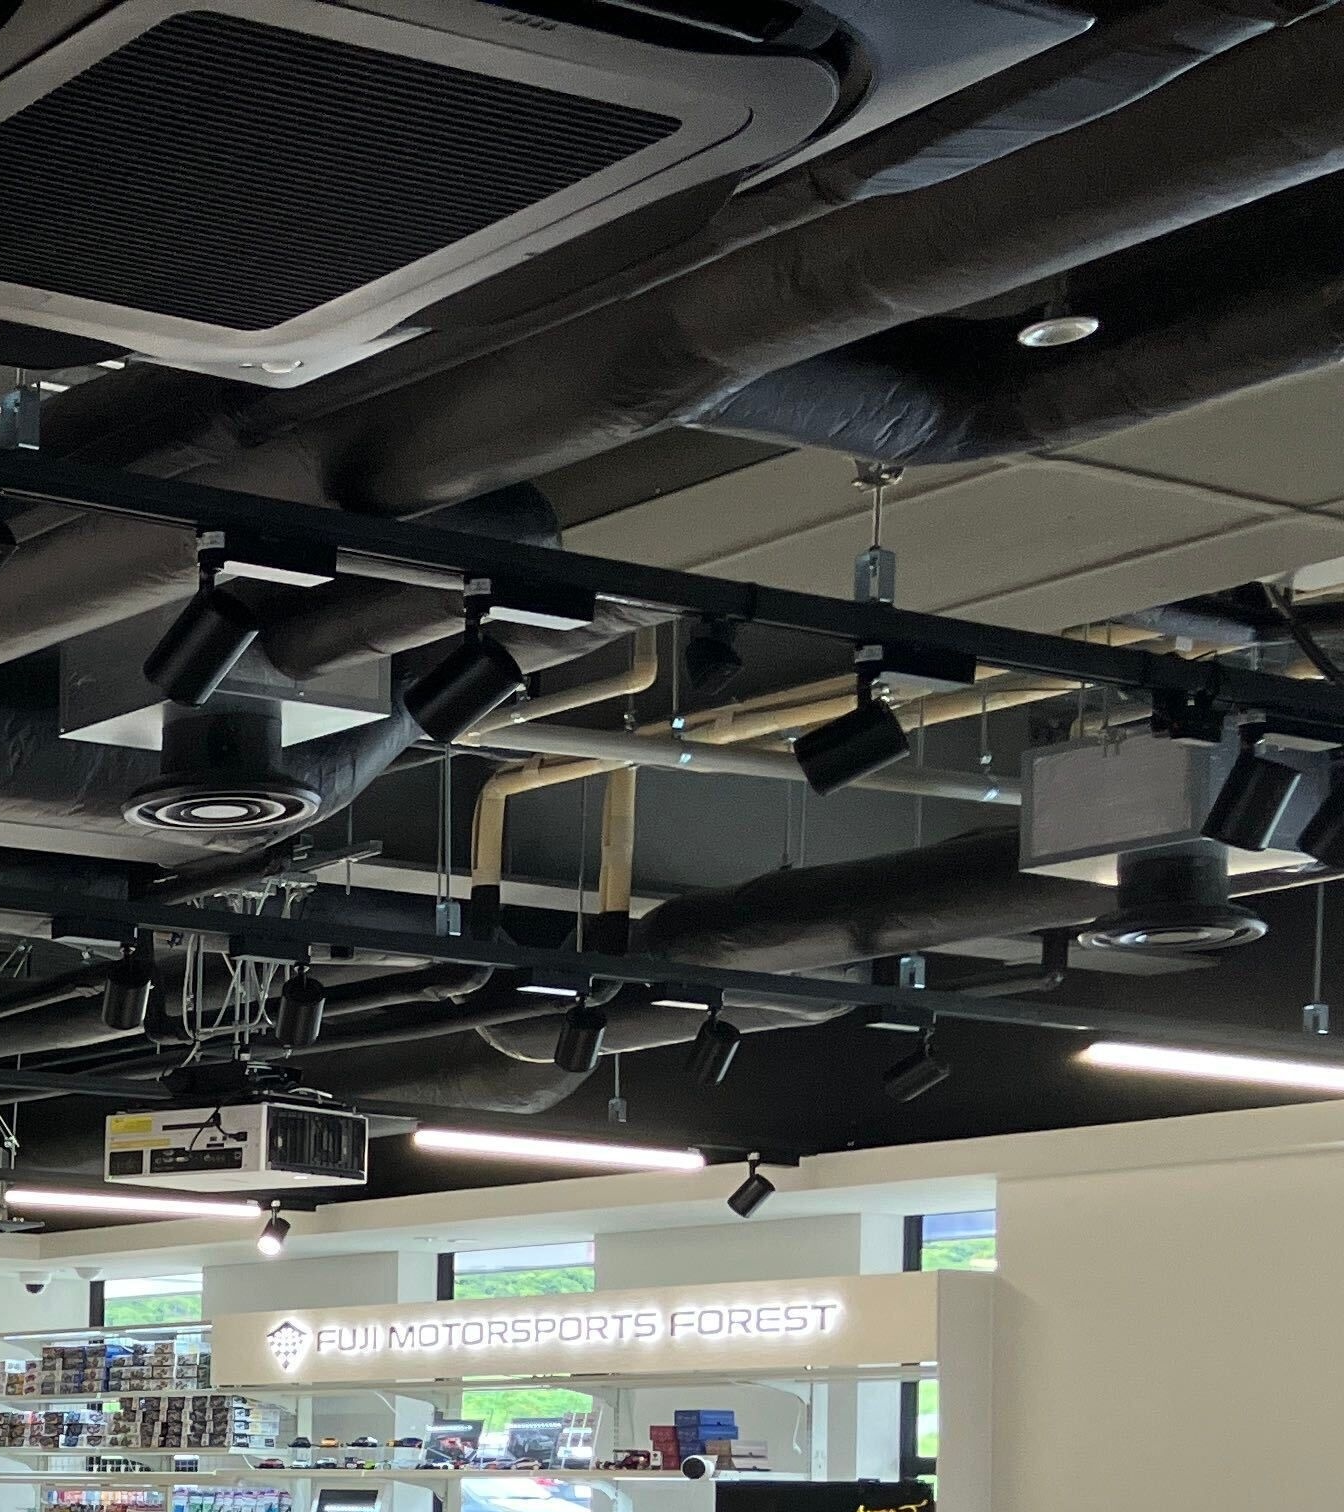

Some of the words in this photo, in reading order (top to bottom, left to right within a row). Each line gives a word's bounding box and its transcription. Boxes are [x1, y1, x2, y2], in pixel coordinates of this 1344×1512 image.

[316, 1326, 377, 1352] FUJI
[388, 1312, 657, 1349] MOTORSPORTS
[670, 1304, 838, 1338] FOREST
